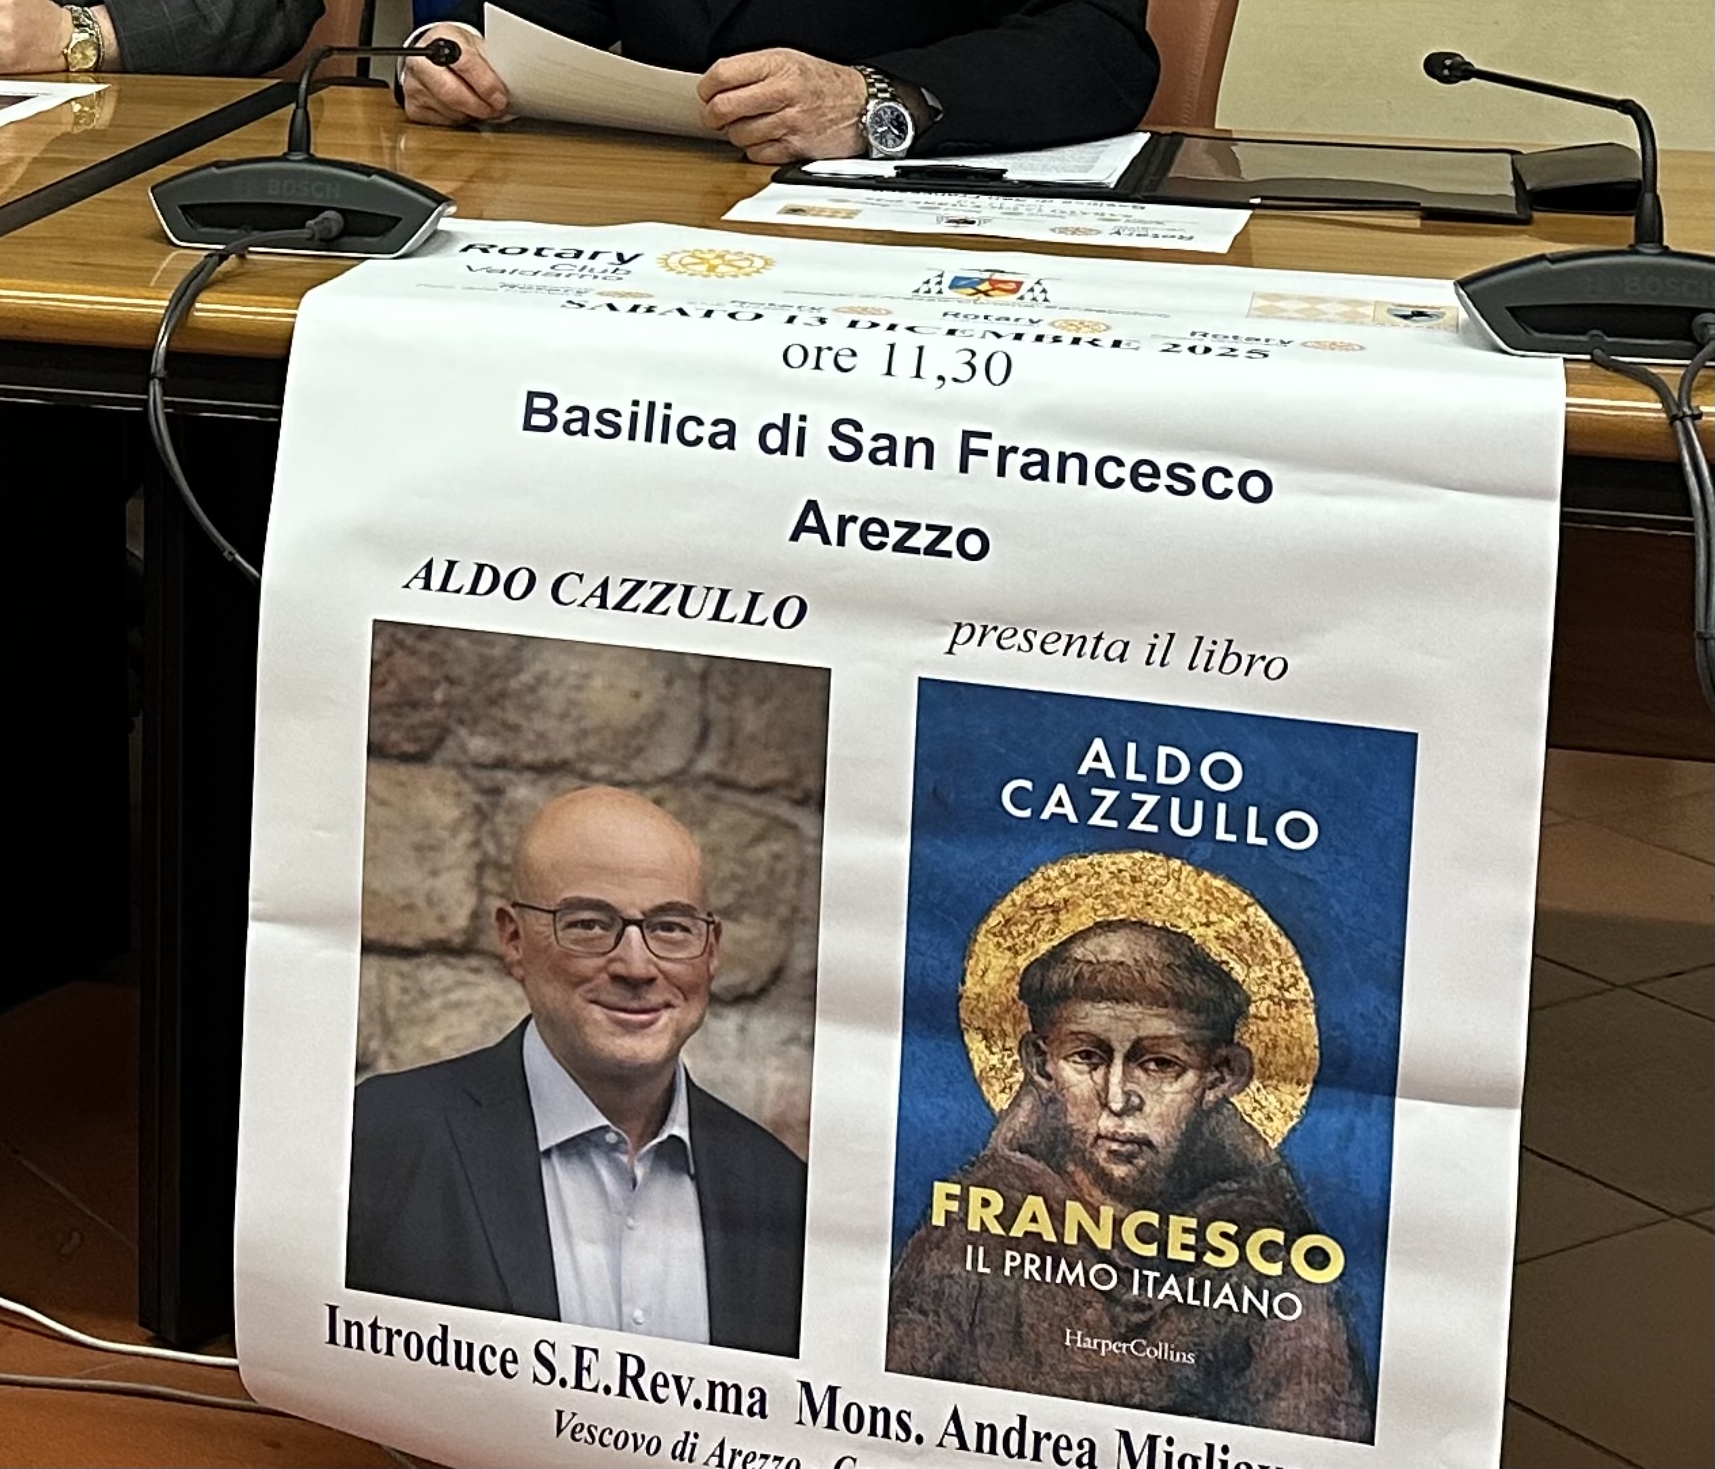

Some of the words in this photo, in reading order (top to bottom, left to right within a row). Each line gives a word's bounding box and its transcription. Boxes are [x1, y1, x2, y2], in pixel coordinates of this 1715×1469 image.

[267, 180, 340, 198] BOSCH
[459, 243, 644, 265] Rotary
[560, 299, 764, 322] SABATO
[785, 315, 829, 326] 13
[846, 320, 1141, 351] DICEMBRE
[1158, 343, 1271, 360] 2025
[783, 343, 858, 373] ore
[881, 342, 1012, 390] 11,30
[521, 390, 737, 451] Basilica
[757, 413, 807, 459] di
[827, 417, 936, 471] San
[958, 429, 1275, 505] Francesco
[788, 498, 992, 563] Arezzo
[402, 556, 538, 603] ALDO
[549, 571, 809, 631] CAZZULLO
[944, 615, 1130, 667] presenta
[1143, 629, 1175, 669] il
[1186, 636, 1290, 684] libro
[1077, 737, 1243, 792] ALDO
[1001, 778, 1319, 850] CAZZULLO
[931, 1181, 1345, 1284] FRANCESCO
[965, 1245, 990, 1274] IL
[1003, 1251, 1118, 1291] PRIMO
[1132, 1269, 1303, 1322] ITALIANO
[1064, 1328, 1195, 1364] HarperCollins
[324, 1304, 519, 1379] Introduce
[532, 1338, 768, 1420] S.E.Rev.ma
[794, 1380, 924, 1445] Mons.
[935, 1404, 1098, 1469] Andrea
[553, 1409, 662, 1457] Vescovo
[670, 1431, 699, 1463] di
